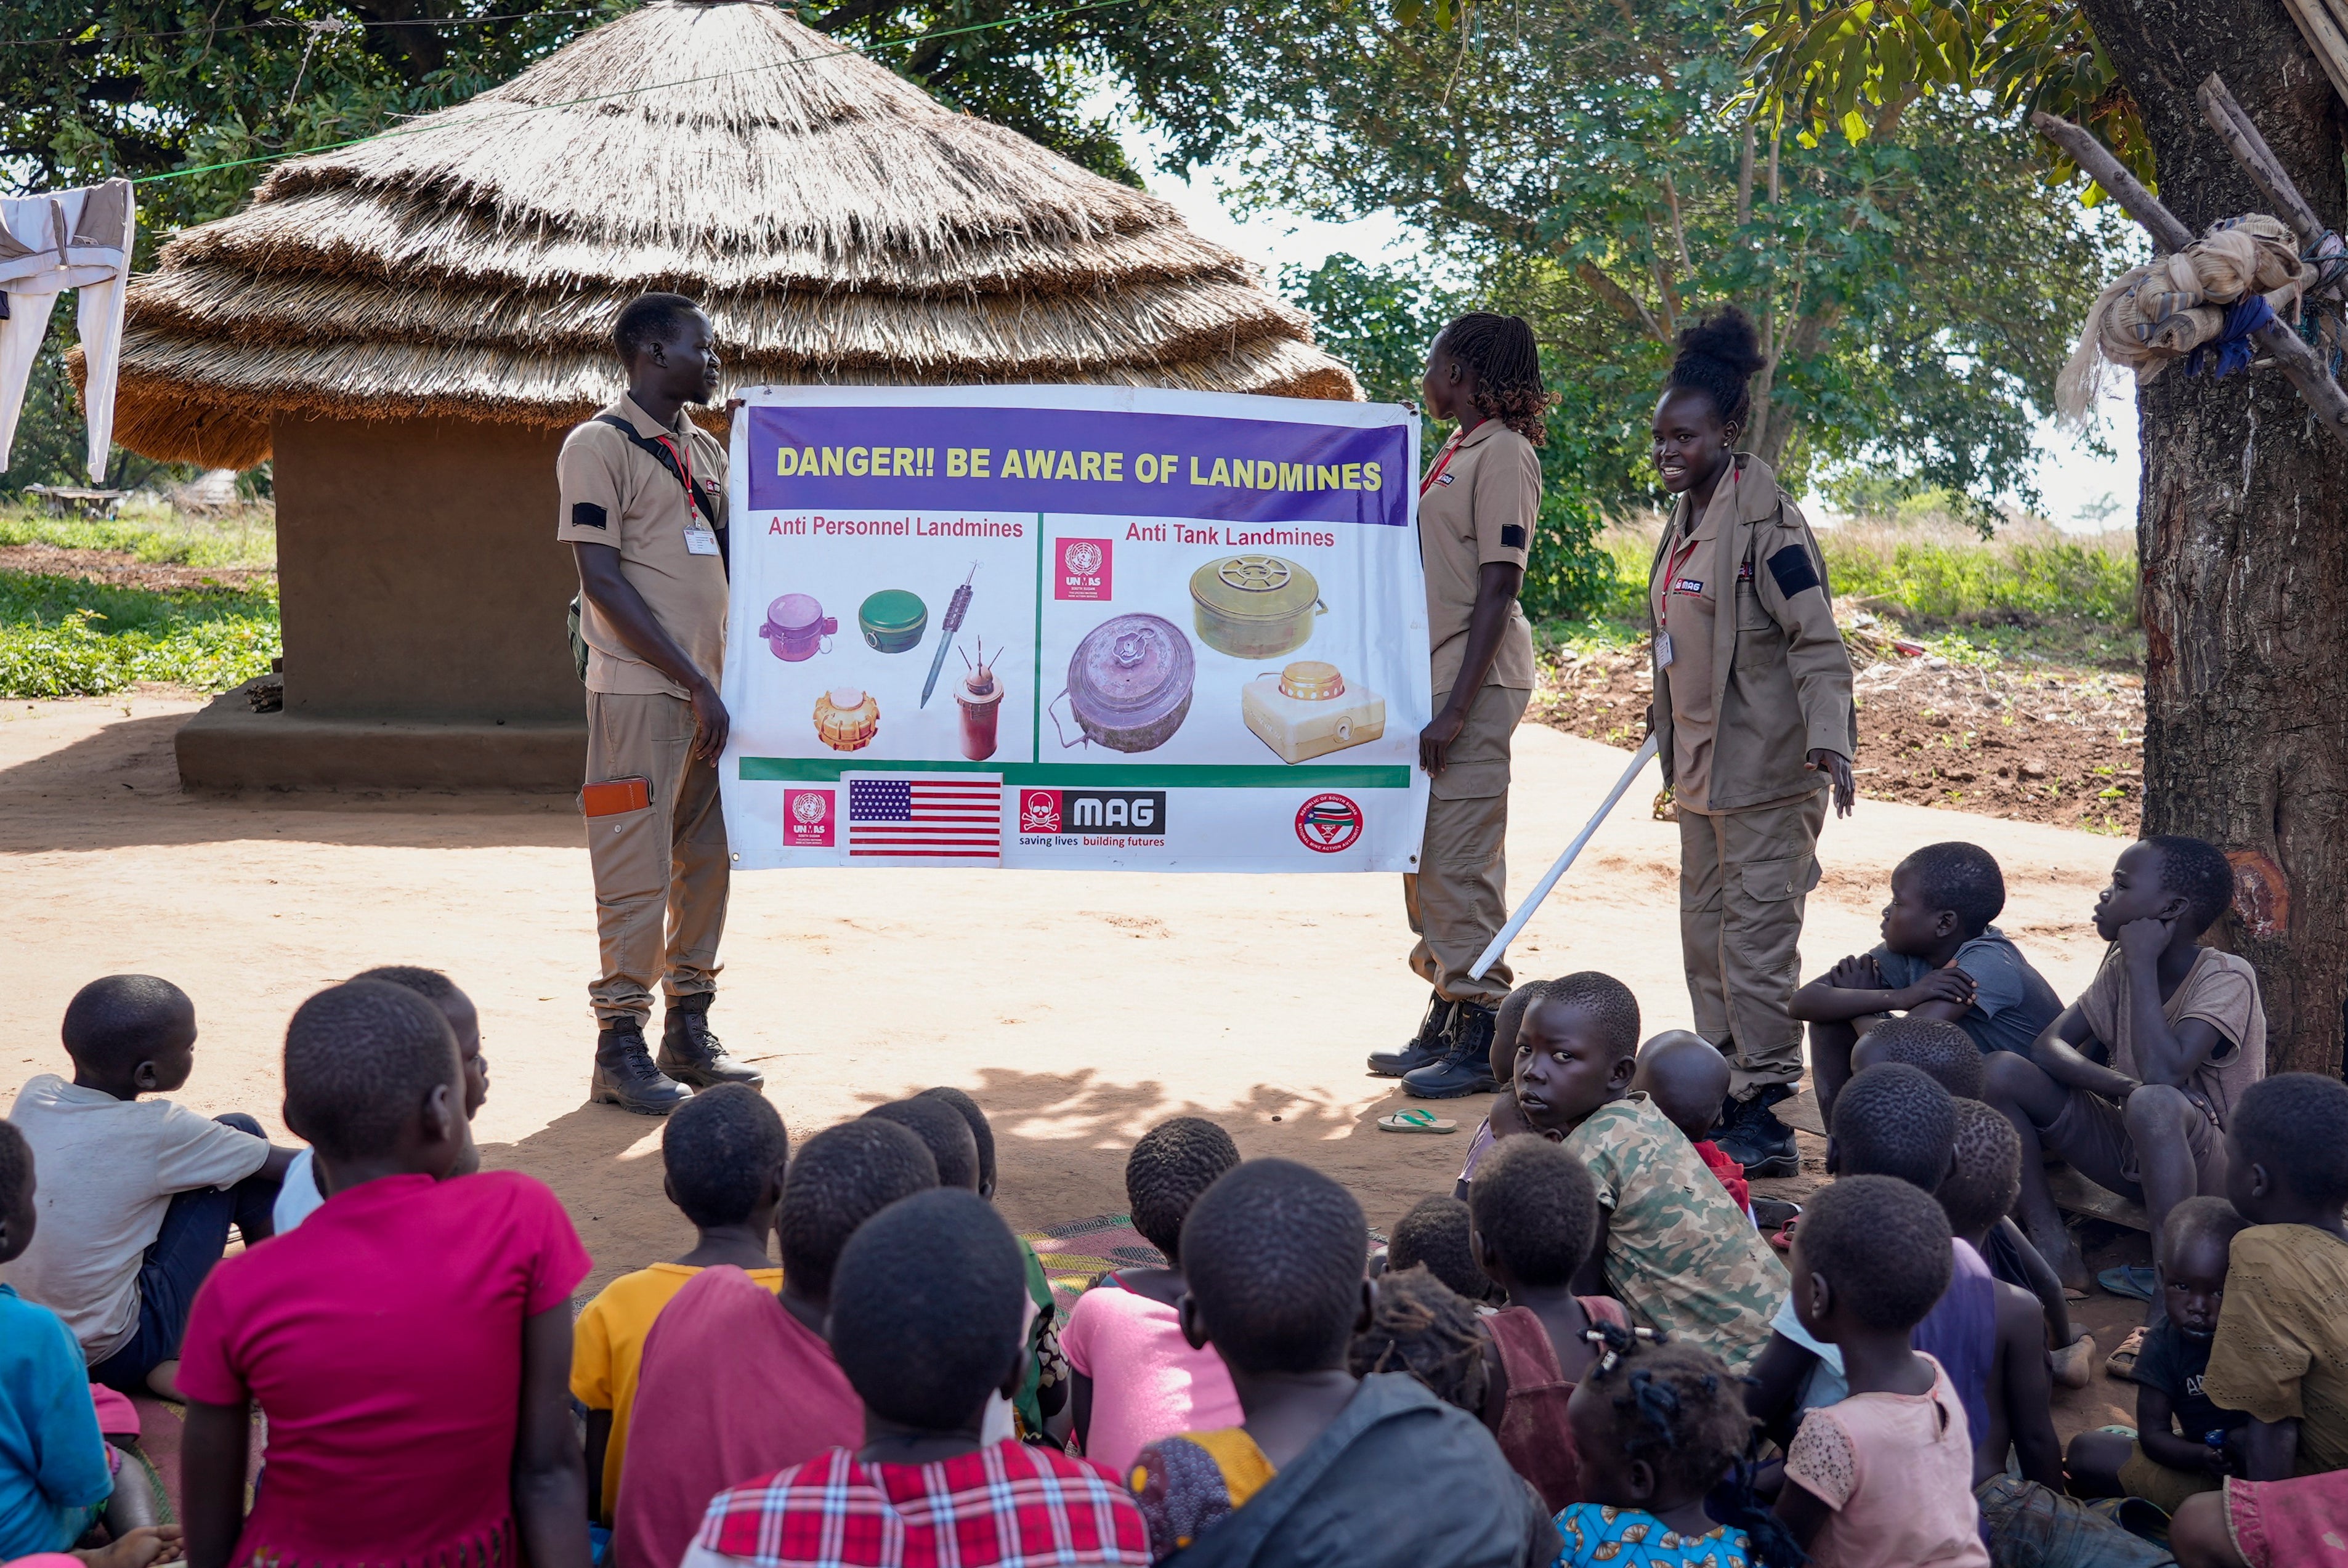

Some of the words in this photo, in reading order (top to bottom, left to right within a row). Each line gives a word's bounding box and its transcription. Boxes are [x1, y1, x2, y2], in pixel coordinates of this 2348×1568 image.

[777, 447, 934, 477] DANGER!!
[946, 448, 990, 478] BE
[1000, 450, 1124, 480] AWARE
[1135, 453, 1179, 483] OF
[1190, 456, 1383, 491] LANDMINES
[769, 516, 806, 535] Anti
[813, 516, 910, 536] Personnel
[917, 518, 1024, 537] Landmines
[1126, 522, 1167, 542] Anti
[1173, 524, 1219, 544] Tank
[1226, 527, 1335, 547] Landmines
[1681, 581, 1701, 591] MAG
[1074, 798, 1154, 827] MAG
[1019, 836, 1052, 847] saving
[1055, 836, 1079, 846] lives
[1083, 836, 1125, 848] building
[1127, 836, 1165, 847] futures
